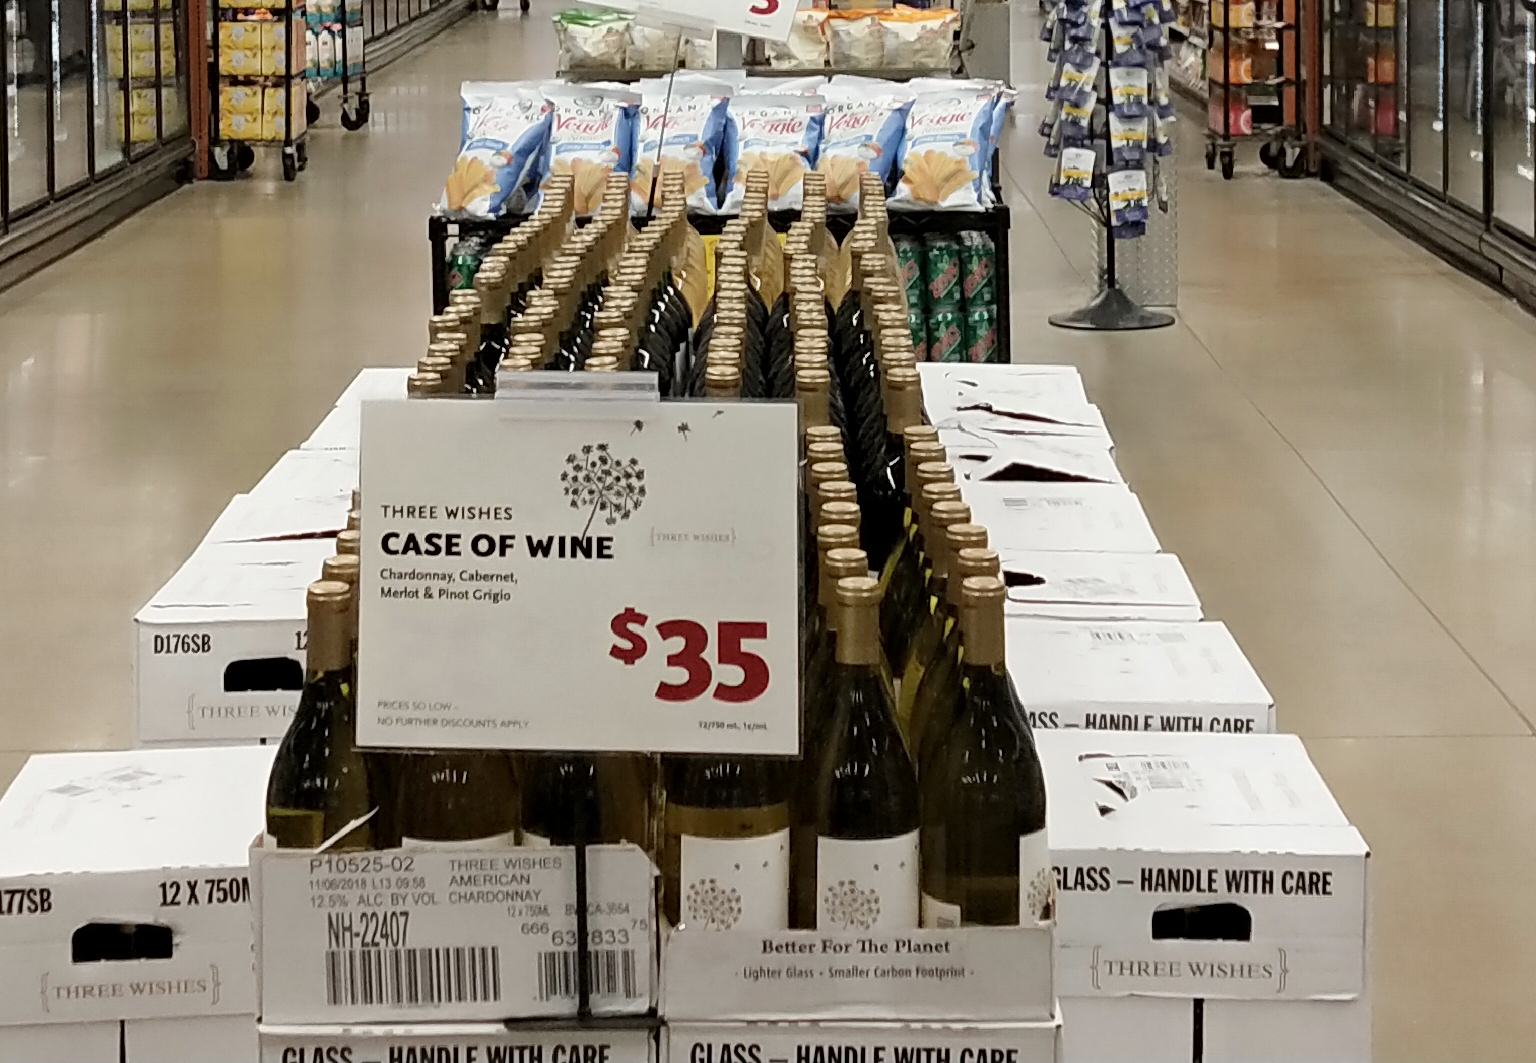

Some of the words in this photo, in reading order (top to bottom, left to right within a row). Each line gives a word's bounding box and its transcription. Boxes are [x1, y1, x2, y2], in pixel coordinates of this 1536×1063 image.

[381, 505, 438, 519] THREE
[445, 506, 514, 520] WISHES
[381, 532, 462, 556] CASE
[470, 533, 516, 557] OF
[525, 535, 614, 559] WINE
[380, 568, 456, 584] Chardonnay,
[459, 569, 519, 585] Cabernet,
[380, 587, 420, 600] Merlot
[423, 588, 435, 600] &
[438, 588, 469, 600] Pinot
[472, 589, 512, 604] Grigio
[153, 634, 212, 655] D176SB
[609, 606, 771, 703] $35
[199, 705, 260, 719] THREE
[265, 704, 297, 717] WIS
[428, 701, 453, 712] LOW
[377, 716, 394, 726] NO
[395, 717, 439, 727] FURTHER
[441, 718, 498, 728] DISCOUNTS
[499, 720, 530, 729] APPLY
[1028, 711, 1060, 729] ASS
[1085, 712, 1155, 732] HANDLE
[1160, 715, 1204, 733] WITH
[1209, 717, 1255, 734] CARE
[309, 856, 415, 874] P10525-02
[449, 859, 499, 872] THREE
[503, 857, 563, 871] WISHES
[449, 874, 531, 888] AMERICAN
[1140, 867, 1218, 895] HANDLE
[1225, 870, 1274, 895] WITH
[1281, 871, 1334, 896] CARE
[158, 881, 182, 907] 12
[186, 879, 199, 905] X
[357, 893, 383, 908] ALC
[390, 892, 408, 907] BY
[411, 891, 438, 906] VOL
[449, 889, 542, 905] CHARDONNAY
[327, 911, 410, 949] NH-22407
[521, 922, 550, 935] 666
[552, 929, 630, 947] 63833
[630, 918, 648, 931] 75
[761, 939, 816, 955] Better
[821, 939, 852, 955] For
[856, 939, 889, 955] The
[894, 939, 951, 955] Planet
[743, 965, 782, 981] Lighter
[786, 966, 814, 979] Glass
[828, 966, 870, 979] Smaller
[874, 966, 912, 979] Carbon
[915, 965, 966, 981] Footprint
[1103, 959, 1182, 978] THREE
[1187, 961, 1274, 979] WISHES
[53, 983, 125, 1000] THREE
[129, 979, 208, 997] WISHES
[282, 1045, 353, 1063] GLASS
[389, 1045, 478, 1063] HANDLE
[486, 1045, 543, 1063] WITH
[551, 1045, 611, 1063] CARE
[691, 1042, 762, 1063] GLASS
[796, 1045, 887, 1063] HANDLE
[893, 1047, 951, 1063] WITH
[959, 1048, 1019, 1063] CARE
